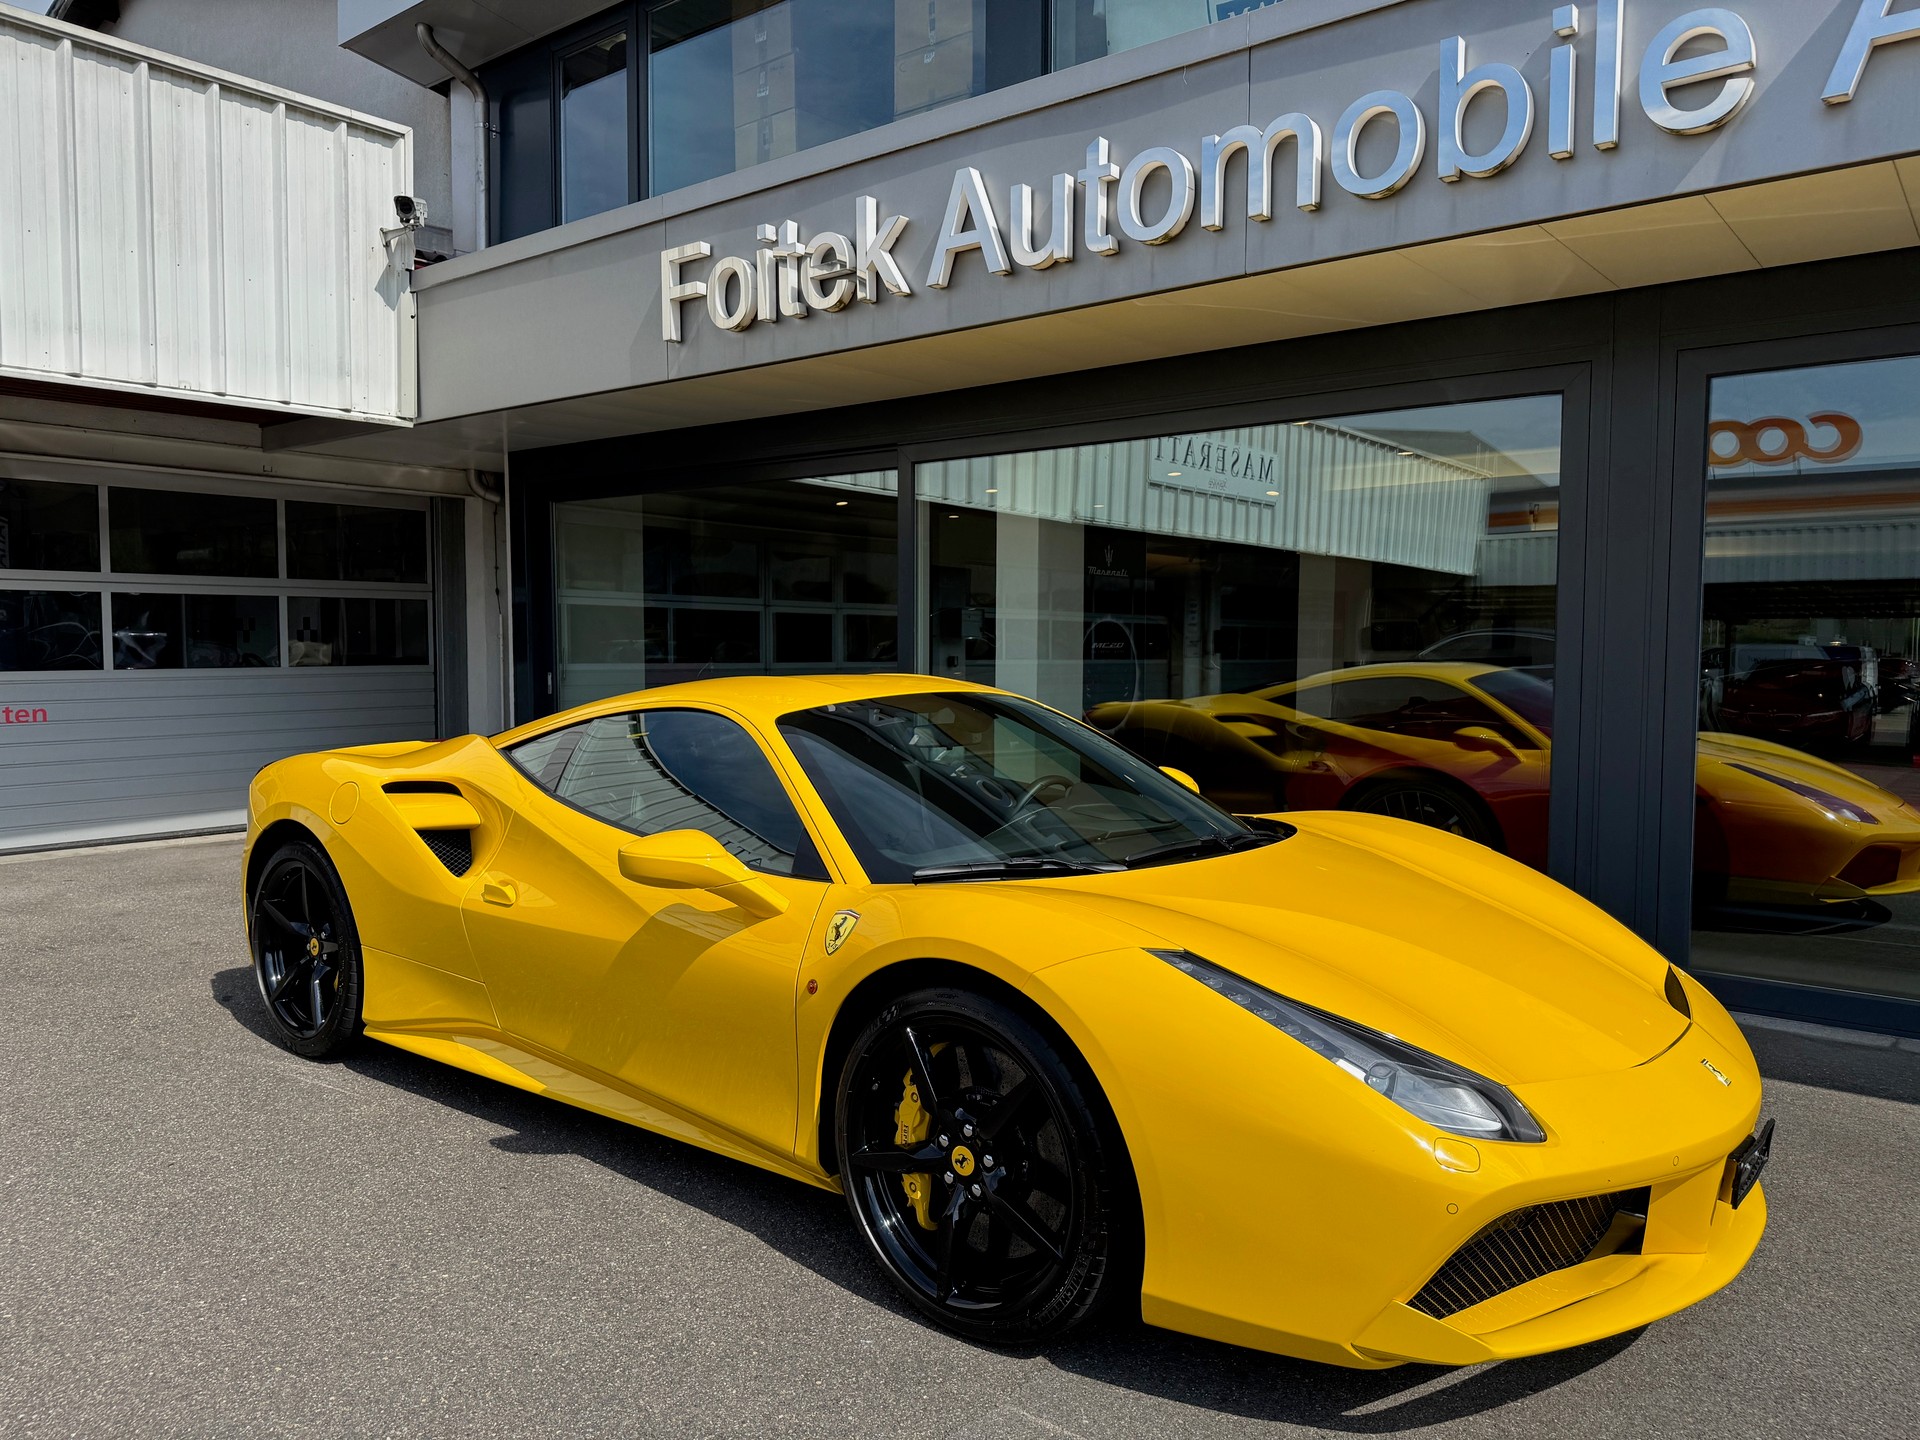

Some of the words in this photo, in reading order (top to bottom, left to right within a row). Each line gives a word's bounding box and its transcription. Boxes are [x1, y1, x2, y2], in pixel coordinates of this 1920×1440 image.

[661, 194, 912, 344] Foitek
[926, 0, 1757, 290] Automobile
[2, 705, 48, 724] ten
